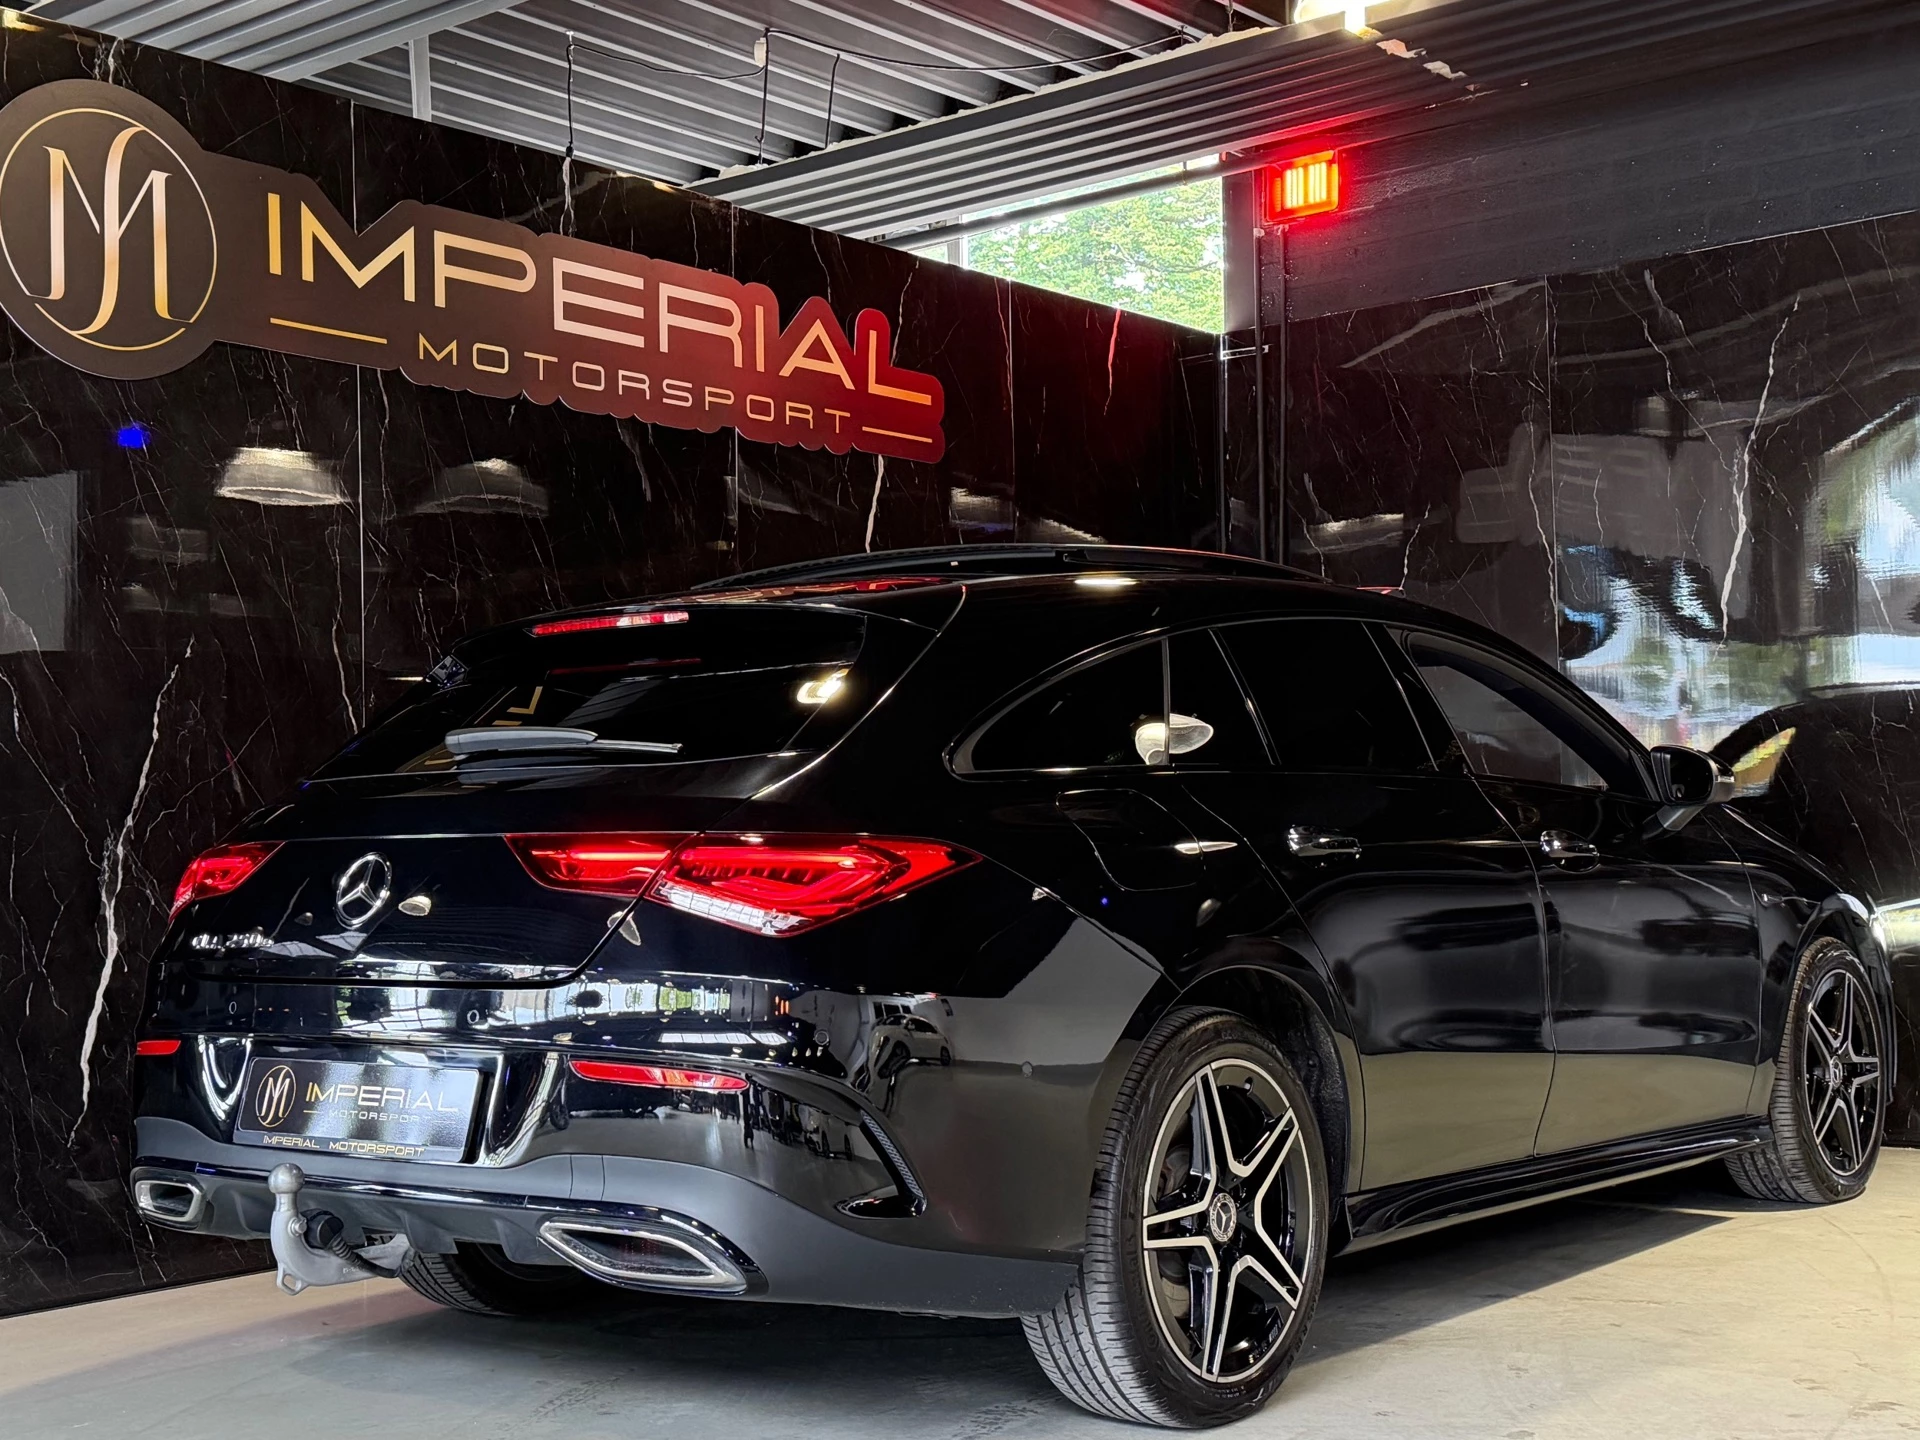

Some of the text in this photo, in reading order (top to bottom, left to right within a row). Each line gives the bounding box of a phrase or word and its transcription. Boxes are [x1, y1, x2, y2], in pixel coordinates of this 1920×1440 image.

[267, 192, 932, 406] IMPERIAL
[417, 332, 851, 435] MOTORSPORT
[305, 1081, 459, 1113] IMPERIAL
[262, 1134, 425, 1157] IMPERIAL MOTORSPORT
